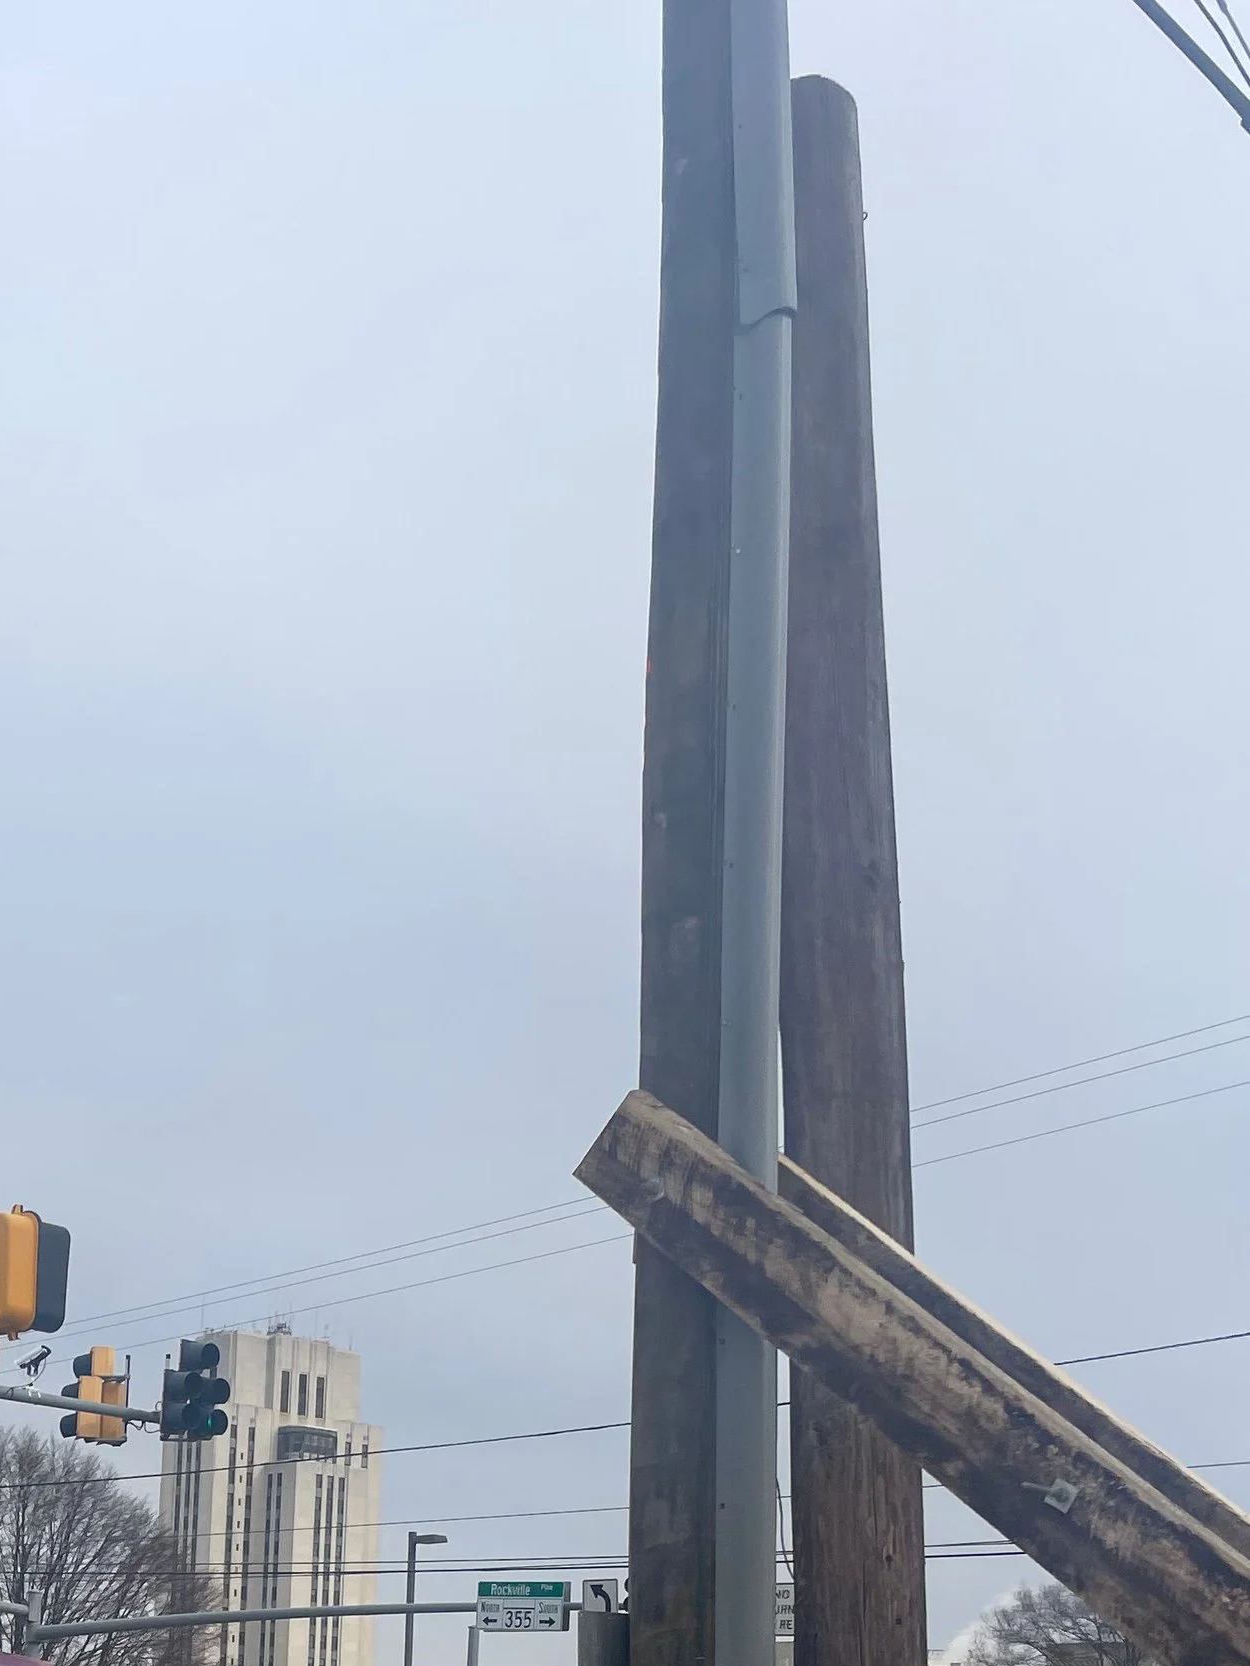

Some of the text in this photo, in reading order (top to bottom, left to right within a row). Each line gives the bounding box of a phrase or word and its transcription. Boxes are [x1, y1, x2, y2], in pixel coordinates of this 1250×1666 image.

[490, 1583, 531, 1596] Rockville
[504, 1610, 532, 1629] 355
[780, 1620, 792, 1629] RE
